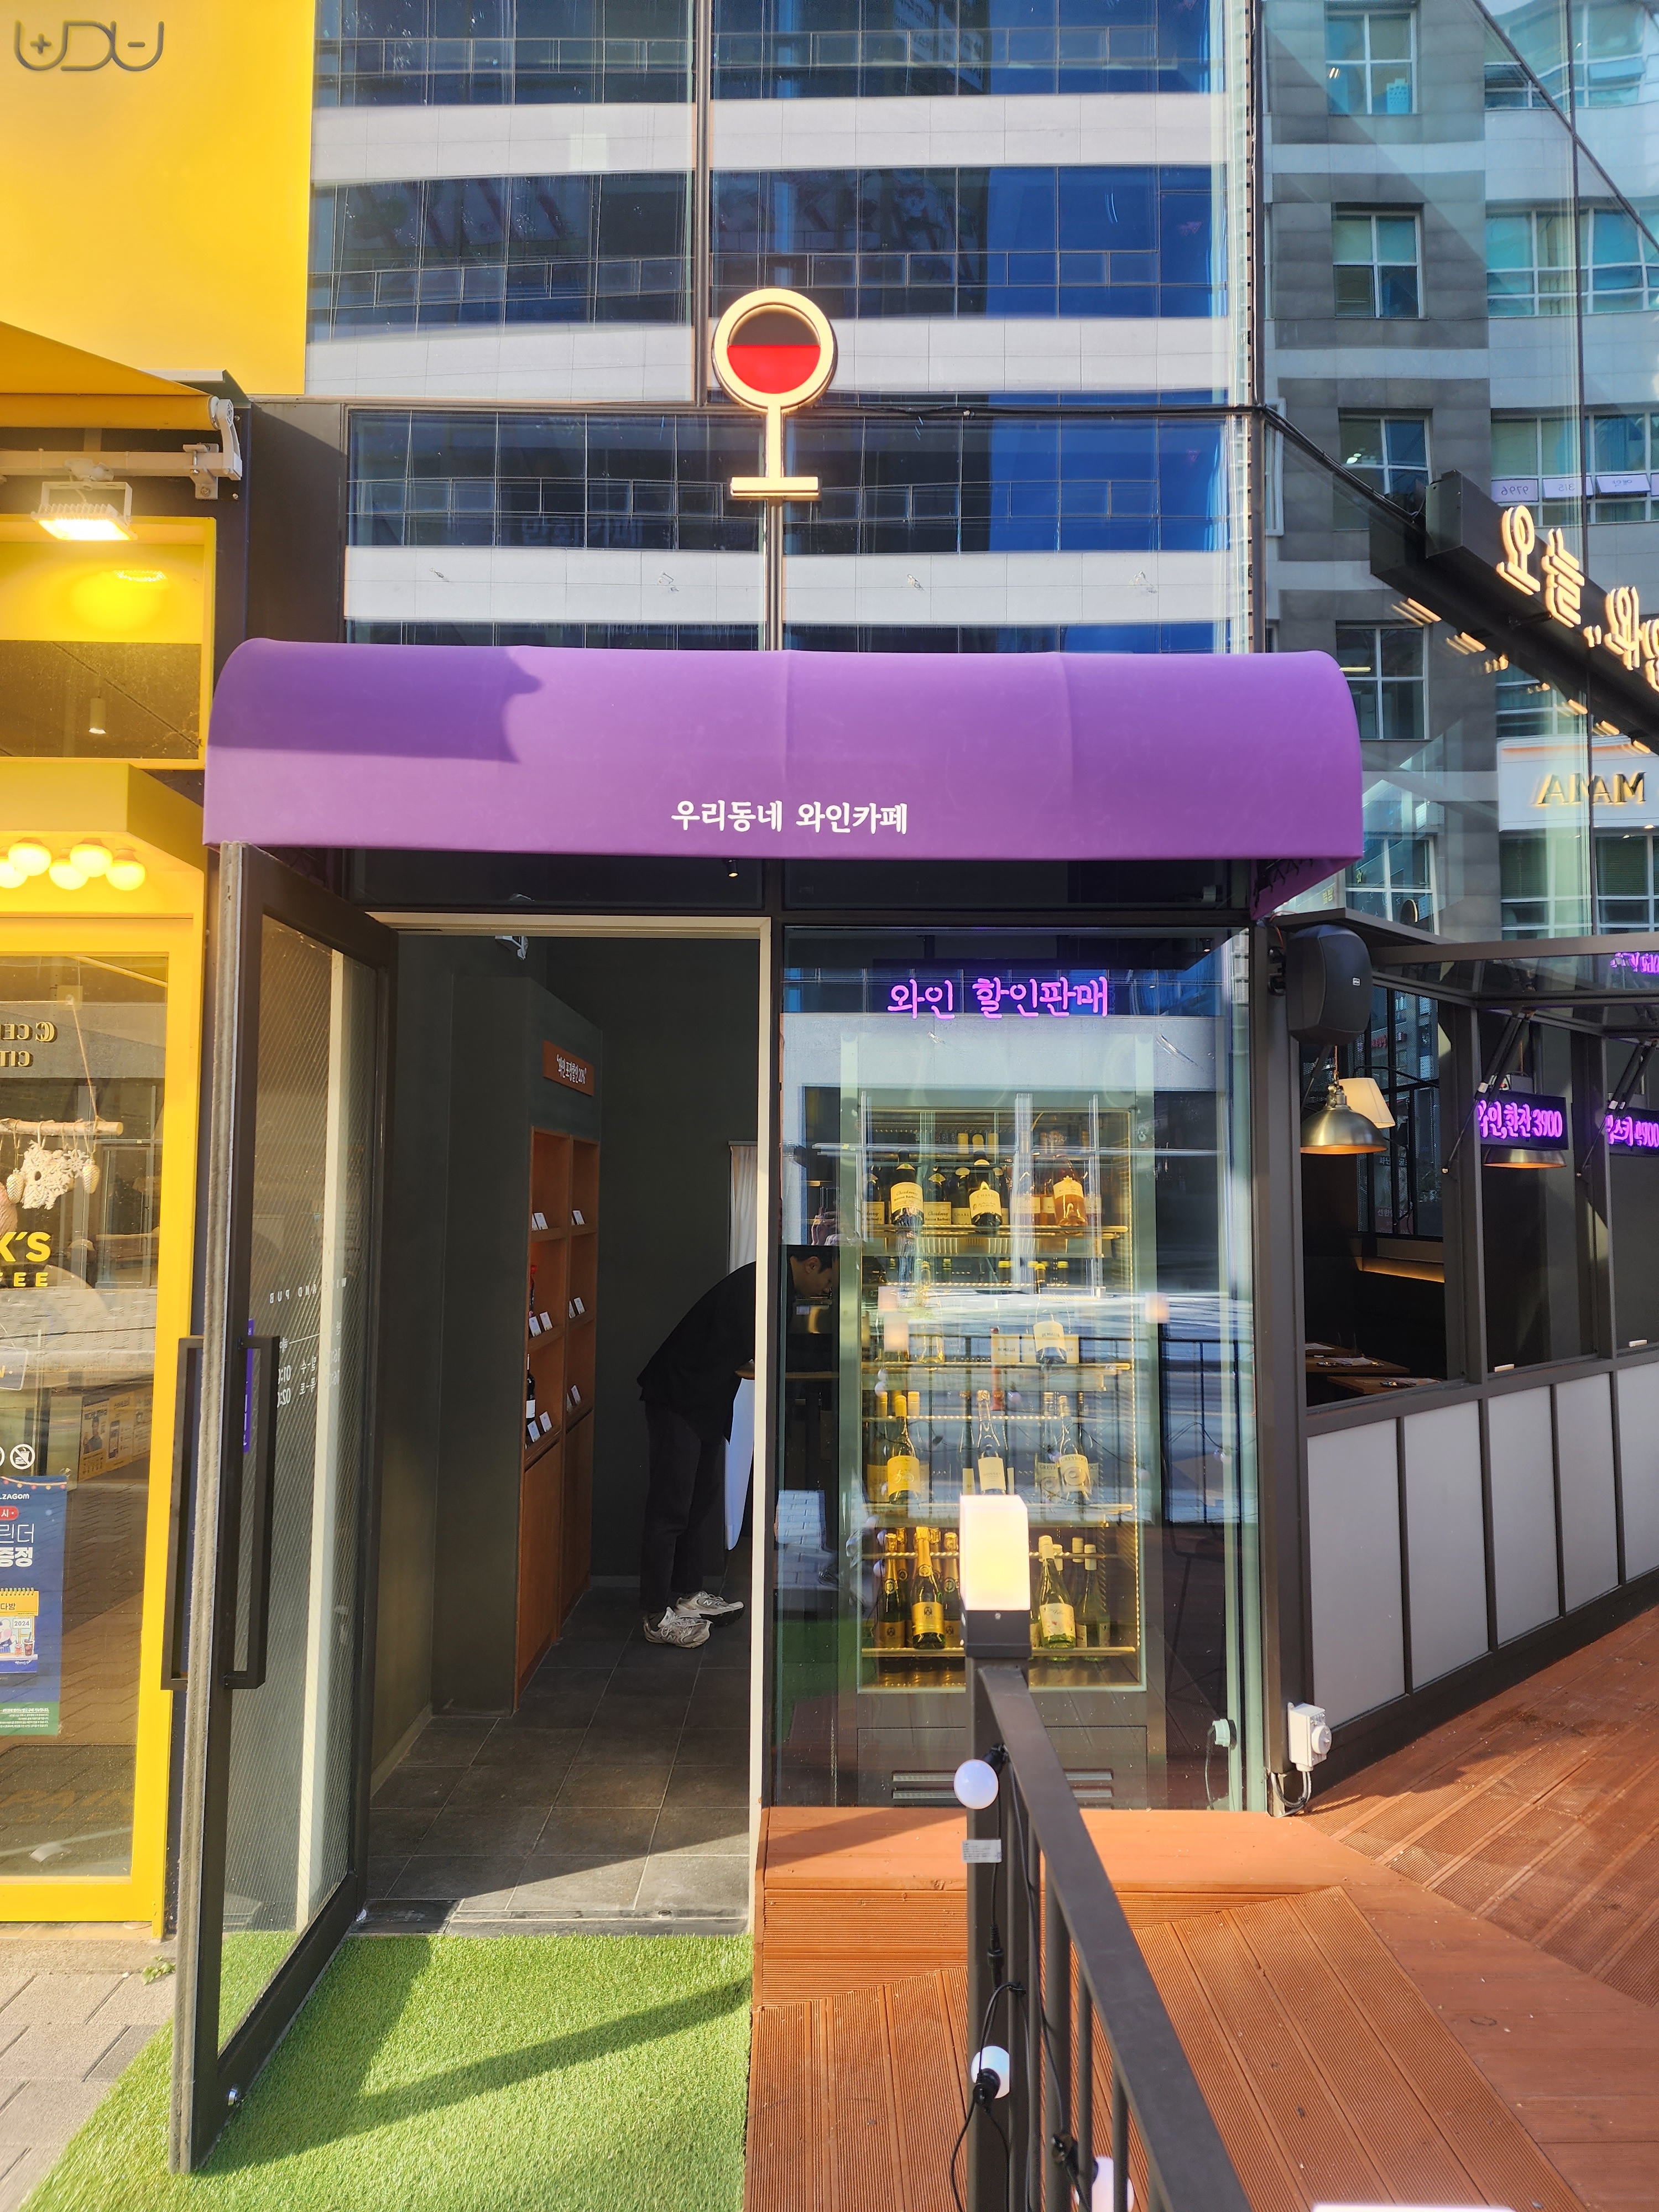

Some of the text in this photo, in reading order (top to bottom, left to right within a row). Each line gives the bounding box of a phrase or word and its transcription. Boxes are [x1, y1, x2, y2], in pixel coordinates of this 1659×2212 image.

[671, 800, 908, 834] 우리동네 와인카페
[887, 976, 1108, 1019] 와인 할인판매
